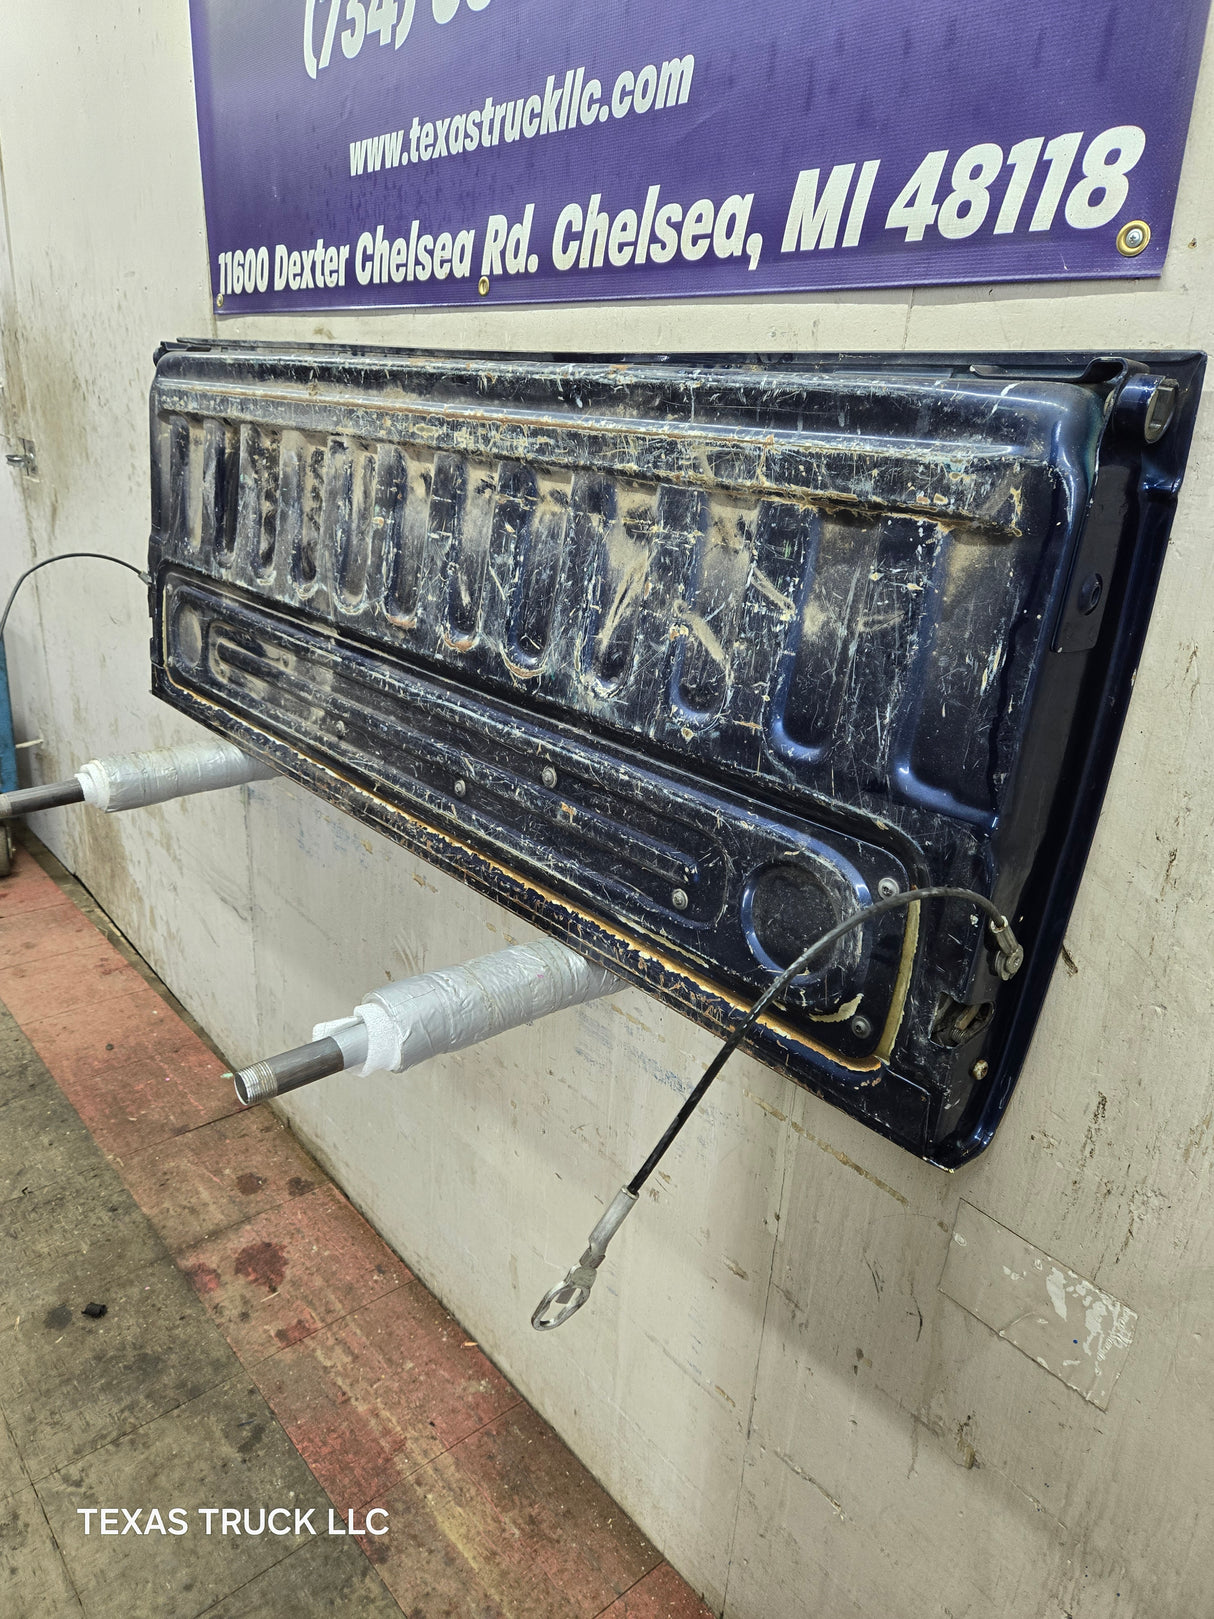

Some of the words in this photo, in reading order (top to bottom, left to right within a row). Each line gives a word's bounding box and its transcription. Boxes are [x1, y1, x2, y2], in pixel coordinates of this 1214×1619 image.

[349, 54, 695, 176] www.texastruckllc.com
[218, 246, 269, 295] 11600
[274, 239, 350, 291] Dexter
[355, 220, 476, 285] Chelsea
[481, 203, 539, 276] Rd.
[552, 185, 763, 271] Chelsea,
[780, 159, 881, 253] MI
[884, 125, 1146, 243] 48118
